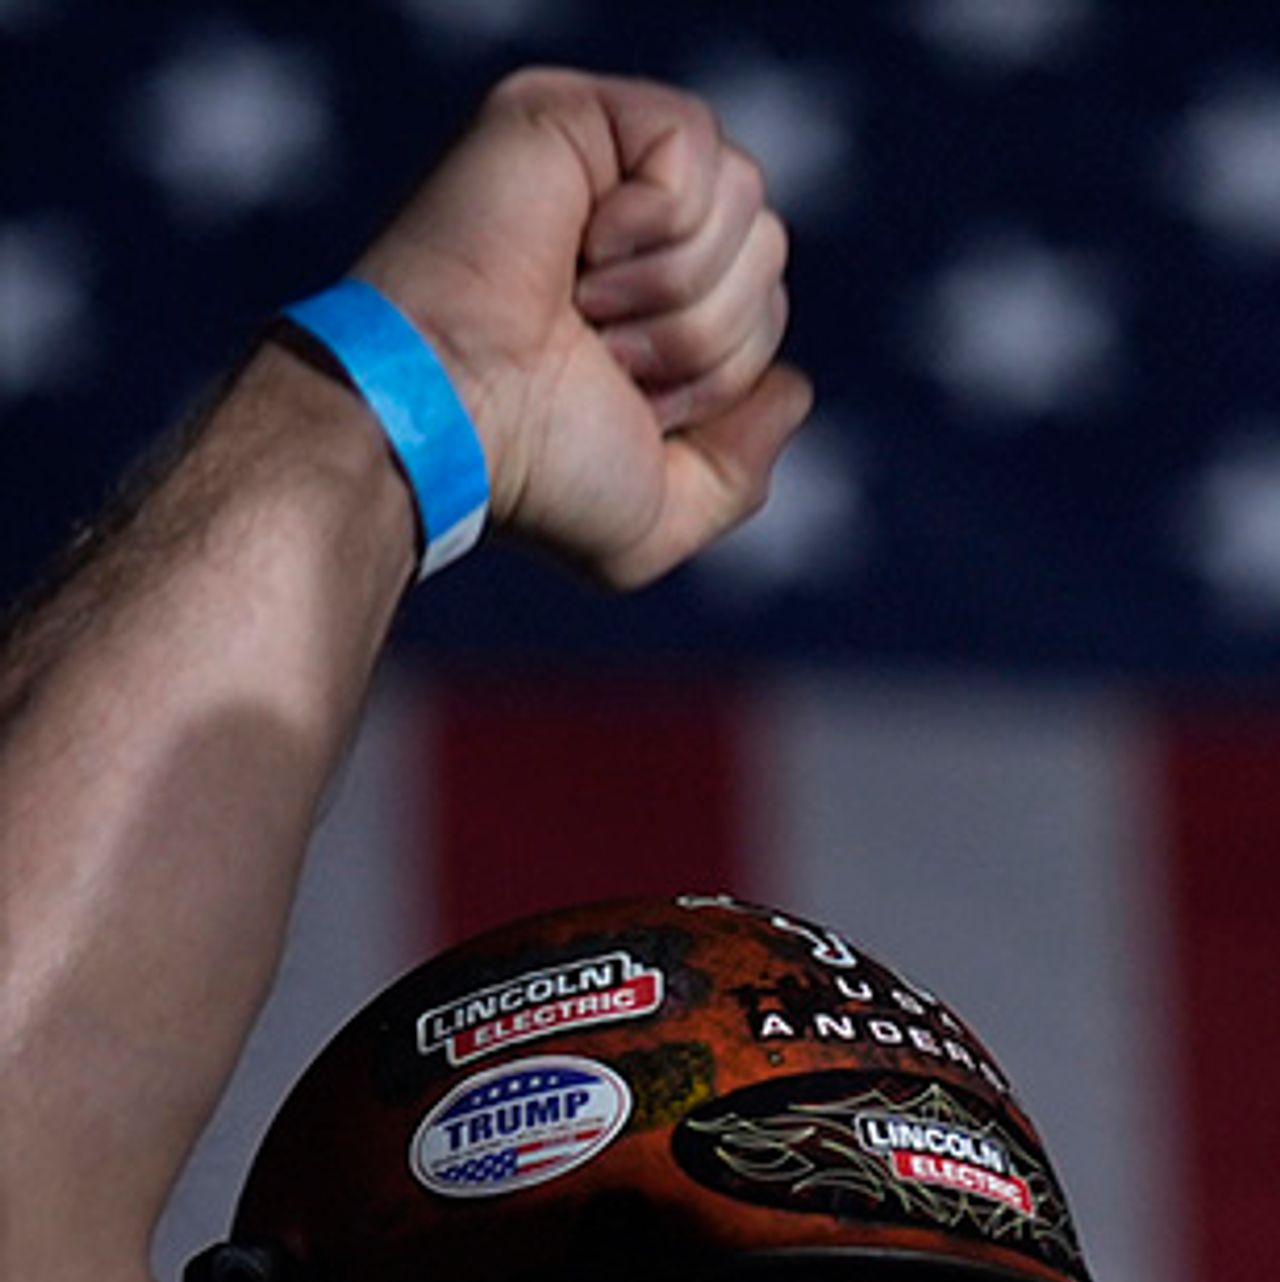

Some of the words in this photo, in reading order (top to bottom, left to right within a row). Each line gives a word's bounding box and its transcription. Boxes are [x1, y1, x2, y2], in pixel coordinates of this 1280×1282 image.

[433, 964, 614, 1038] LINCOLN
[474, 987, 637, 1046] ELECTRIC
[445, 1090, 590, 1151] TRUMP
[866, 1120, 1009, 1174] LINCOLN
[912, 1154, 1024, 1205] ELECTRIC
